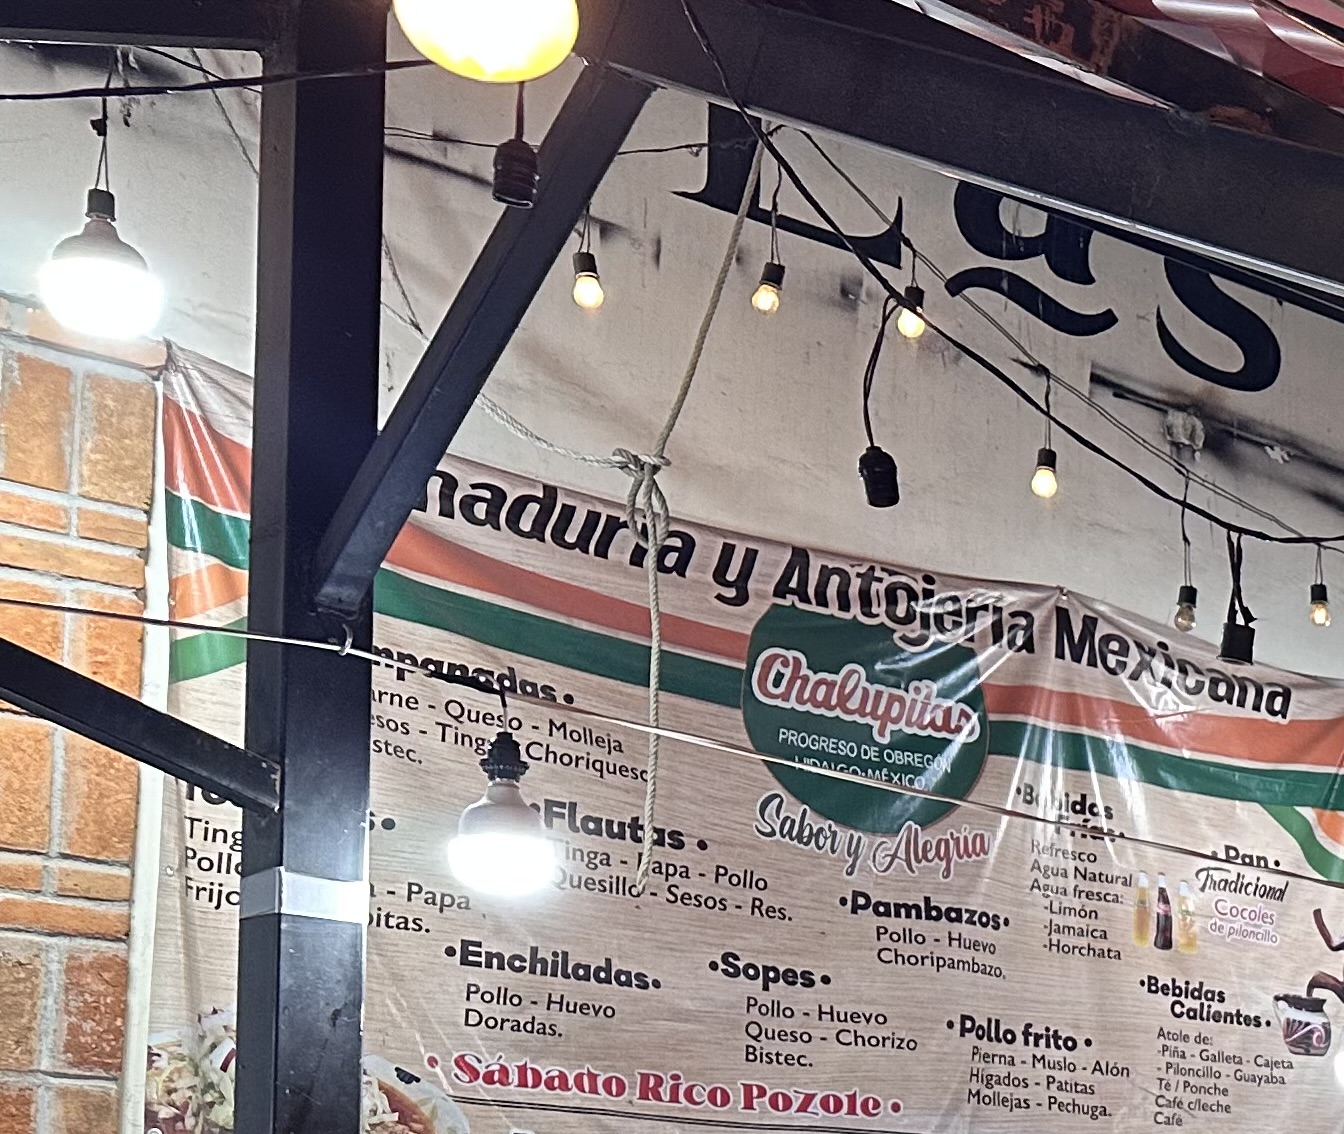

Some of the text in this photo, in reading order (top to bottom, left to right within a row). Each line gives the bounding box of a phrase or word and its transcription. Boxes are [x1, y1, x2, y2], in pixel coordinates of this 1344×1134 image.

[713, 541, 758, 607] y
[1055, 606, 1291, 719] Mexicana
[756, 652, 979, 739] Chalupitas
[435, 720, 491, 757] Ting
[444, 699, 522, 732] Queso
[548, 718, 624, 754] Molleja
[778, 727, 951, 773] PROGRESO DE OBREGÓN
[1022, 783, 1114, 820] Bidas
[184, 815, 243, 852] Ting
[544, 799, 686, 851] Flautas
[754, 793, 990, 880] Sabor y Alegría
[1030, 838, 1097, 864] Refresco
[1224, 844, 1269, 868] Pan
[714, 864, 768, 892] Pollo
[1030, 858, 1133, 888] Agua Natural
[1194, 866, 1290, 902] Tradicional
[184, 875, 241, 910] Frijo
[406, 882, 472, 913] Papa
[665, 884, 728, 912] Sesos
[750, 897, 793, 921] Res.
[1029, 879, 1124, 904] Agua fresca:
[850, 889, 1001, 931] Pambazos
[1214, 899, 1276, 926] Cocoles
[876, 925, 997, 955] Pollo Huevo
[1209, 919, 1279, 947] de piloncillo
[459, 938, 650, 991] Enchiladas
[720, 951, 816, 992] Sopes
[876, 946, 1007, 980] Choripambazo.
[465, 982, 616, 1019] Pollo Huevo
[1146, 974, 1227, 1004] Bebidas
[464, 1008, 563, 1038] Doradas.
[746, 995, 888, 1026] Pollo Huevo
[1170, 999, 1263, 1028] Calientes
[744, 1020, 918, 1051] Queso Chorizo
[959, 1013, 1078, 1052] Pollo frito
[1156, 1026, 1214, 1046] Atole de:
[745, 1044, 813, 1068] Bistec.
[971, 1045, 1130, 1078] Pierna Muslo Alón
[1199, 1048, 1243, 1066] Galleta
[1253, 1054, 1294, 1072] Cajeta
[452, 1053, 884, 1118] Sábado Rico Pozole
[968, 1067, 1096, 1096] Hígados Patitas
[1156, 1077, 1229, 1097] Té Ponche
[1165, 1061, 1286, 1087] Piloncillo Guayaba
[967, 1088, 1113, 1120] Mollejas Pechuga.
[1155, 1095, 1184, 1110] Café
[1153, 1111, 1183, 1127] Café
